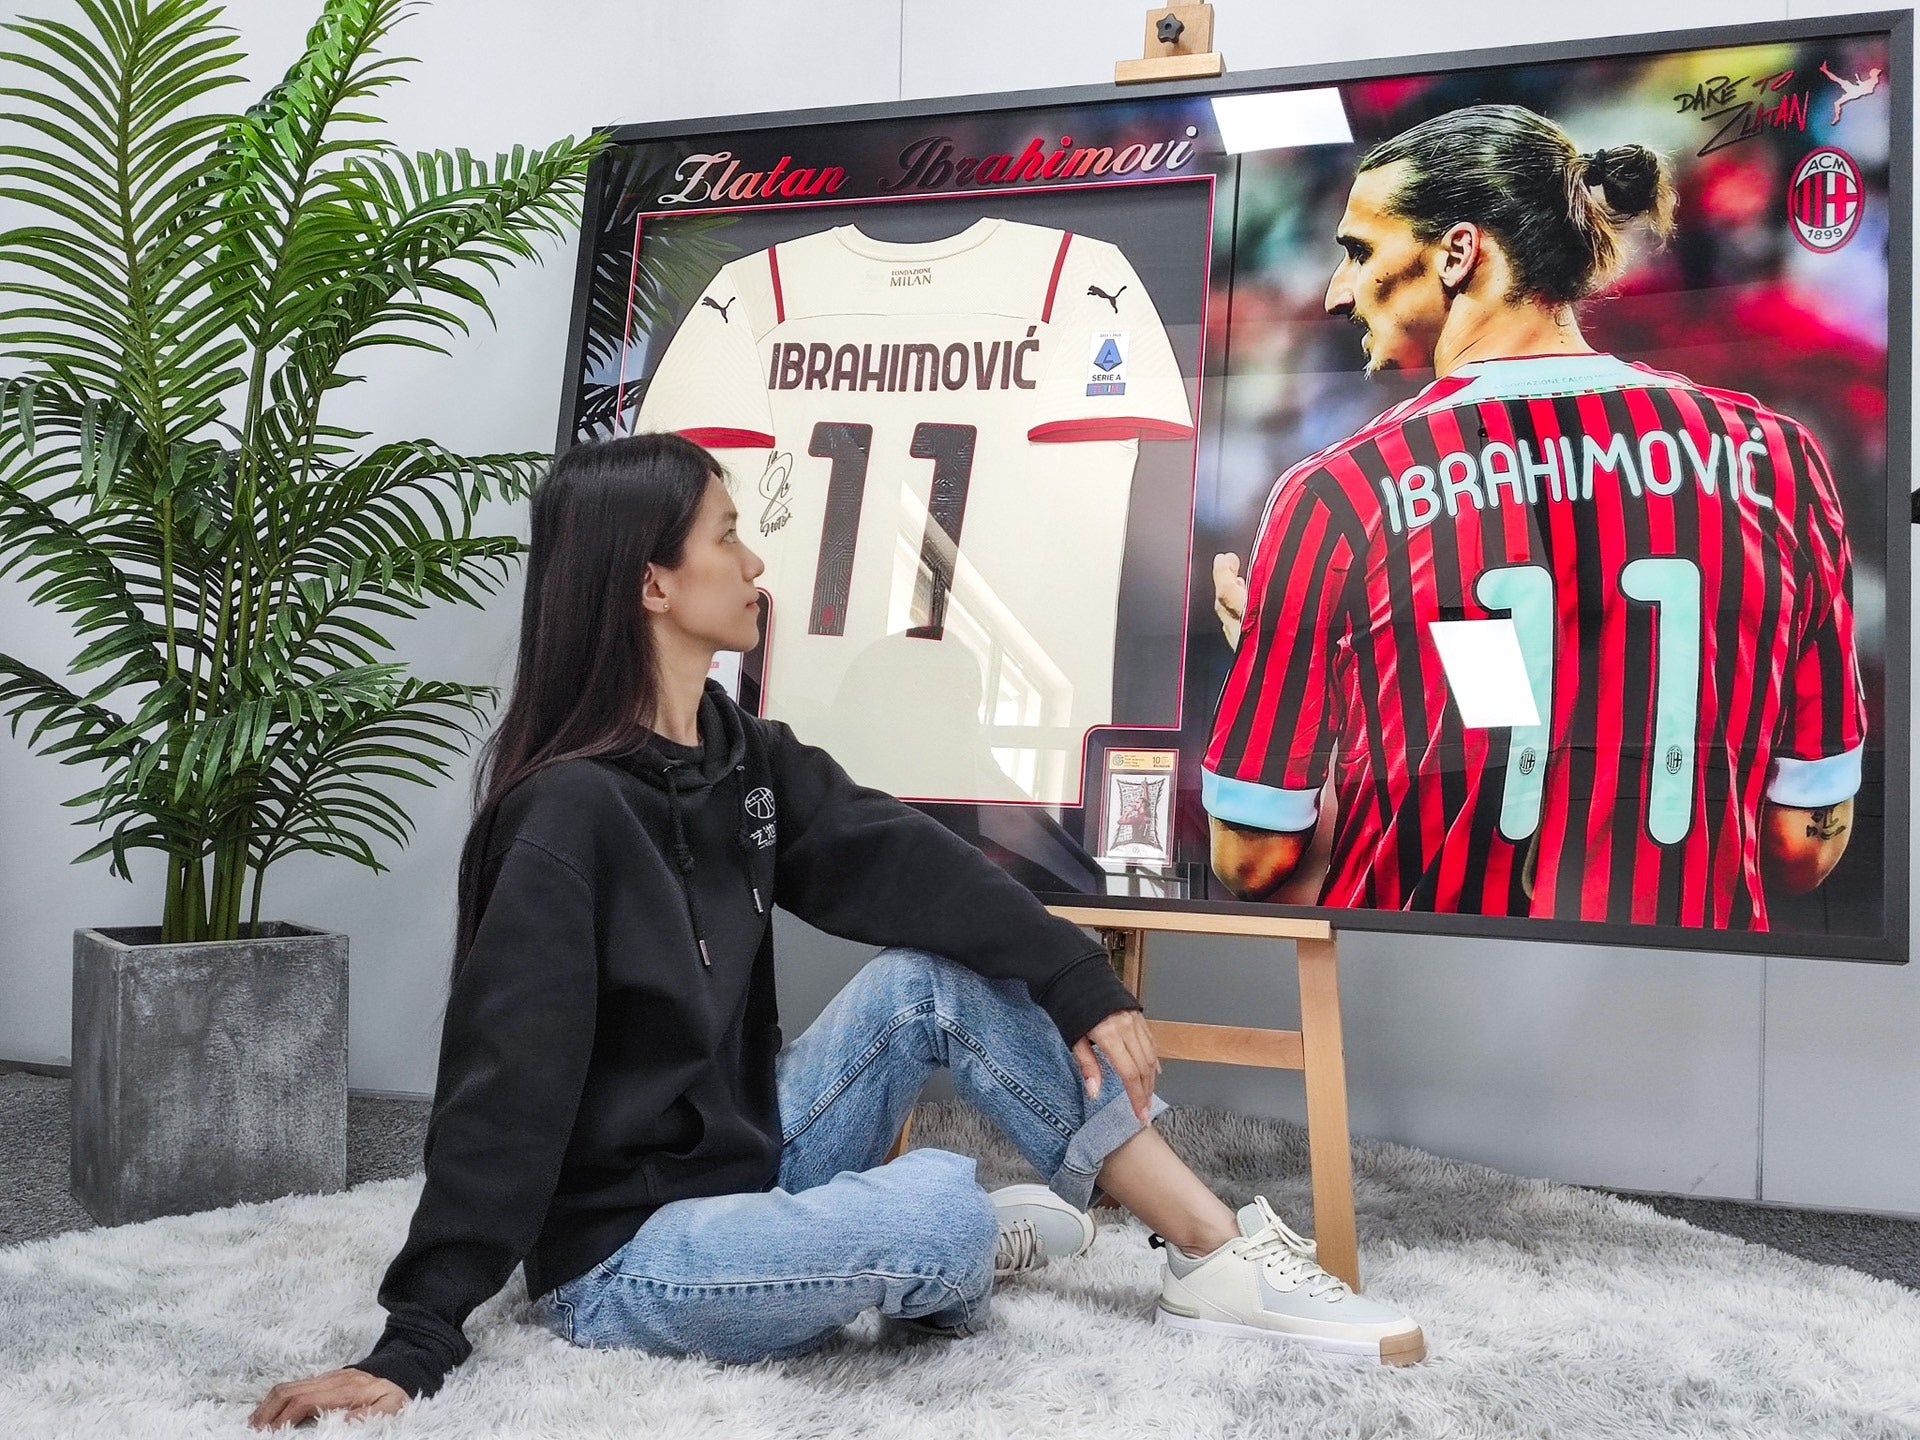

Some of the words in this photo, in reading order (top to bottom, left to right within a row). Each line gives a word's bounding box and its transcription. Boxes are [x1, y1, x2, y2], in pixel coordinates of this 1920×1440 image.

[1673, 76, 1749, 113] DARE
[1752, 70, 1795, 95] TO
[1697, 91, 1810, 157] ZLATAN
[657, 151, 850, 205] Zlatan
[877, 125, 1198, 192] Ibrahimovi
[1804, 155, 1847, 176] ACM
[1807, 227, 1843, 240] 1899
[890, 275, 931, 286] MILAN
[768, 325, 1040, 392] IBRAHIMOVIĆ
[1380, 427, 1773, 535] IBRAHIMOVIĆ
[808, 421, 978, 641] 11
